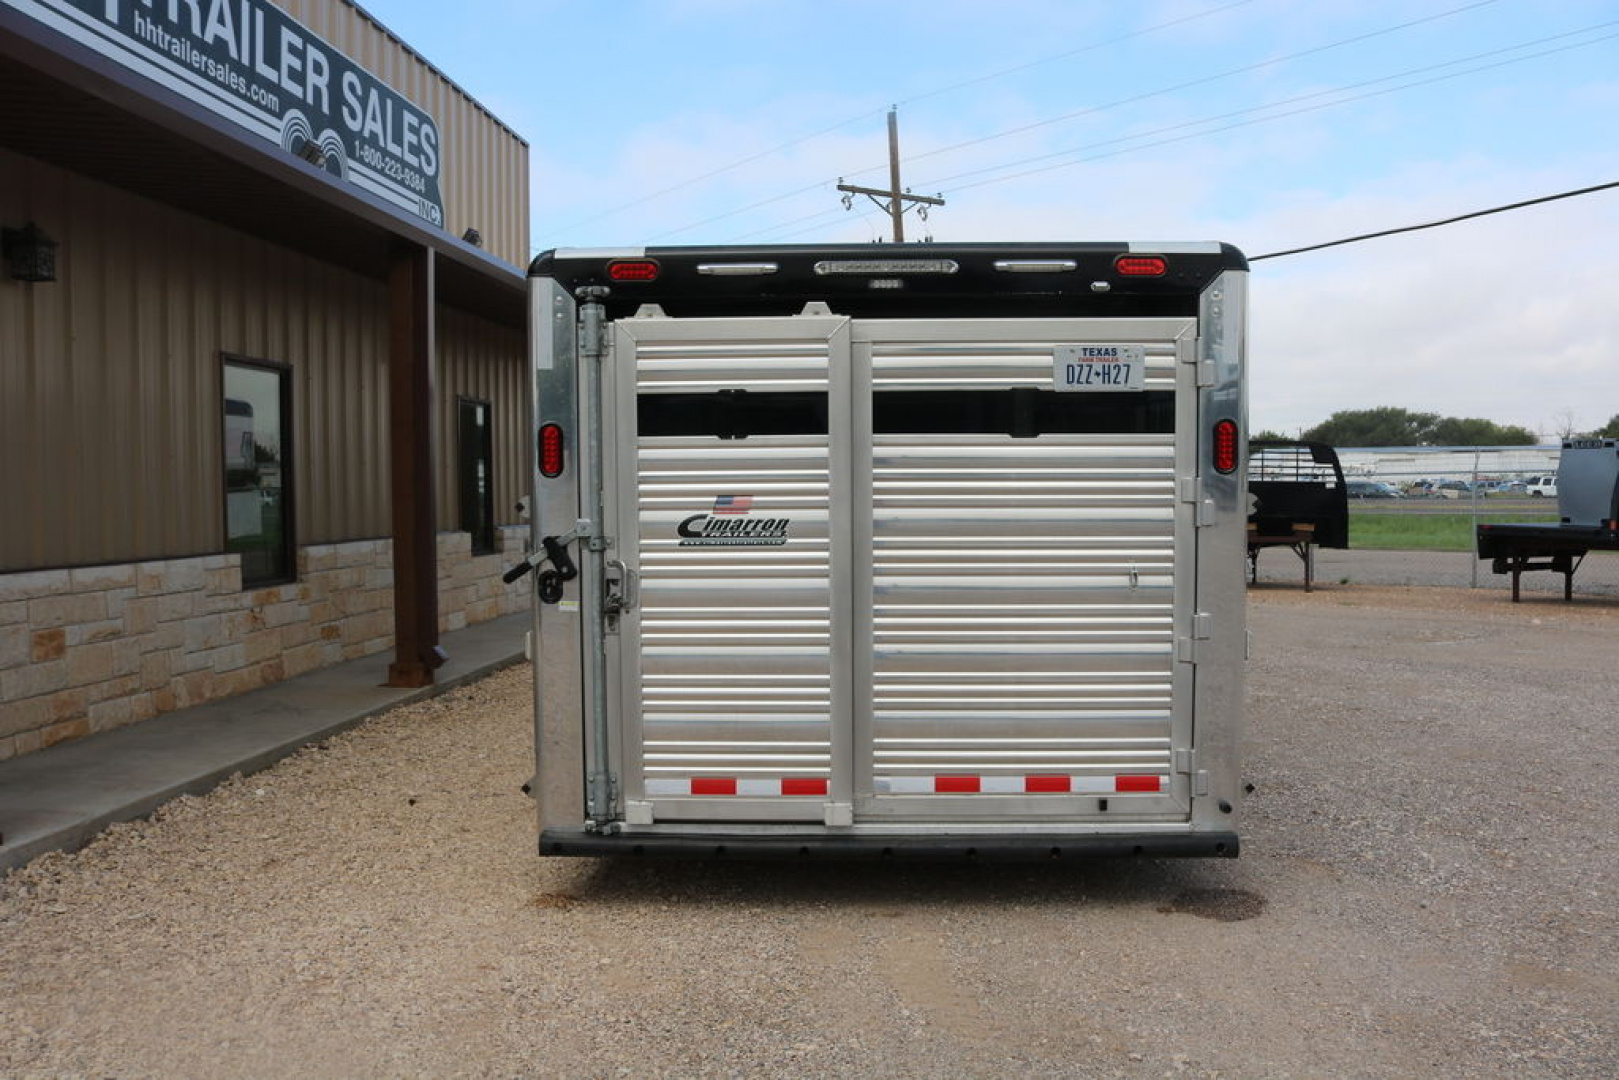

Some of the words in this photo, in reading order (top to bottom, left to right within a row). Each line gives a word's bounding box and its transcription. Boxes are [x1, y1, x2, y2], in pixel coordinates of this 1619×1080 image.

[133, 9, 280, 113] hhtrailersales.com
[141, 0, 331, 116] AILER
[342, 70, 437, 177] SALES
[1082, 347, 1118, 357] TEXAS
[677, 513, 790, 538] Cimarron
